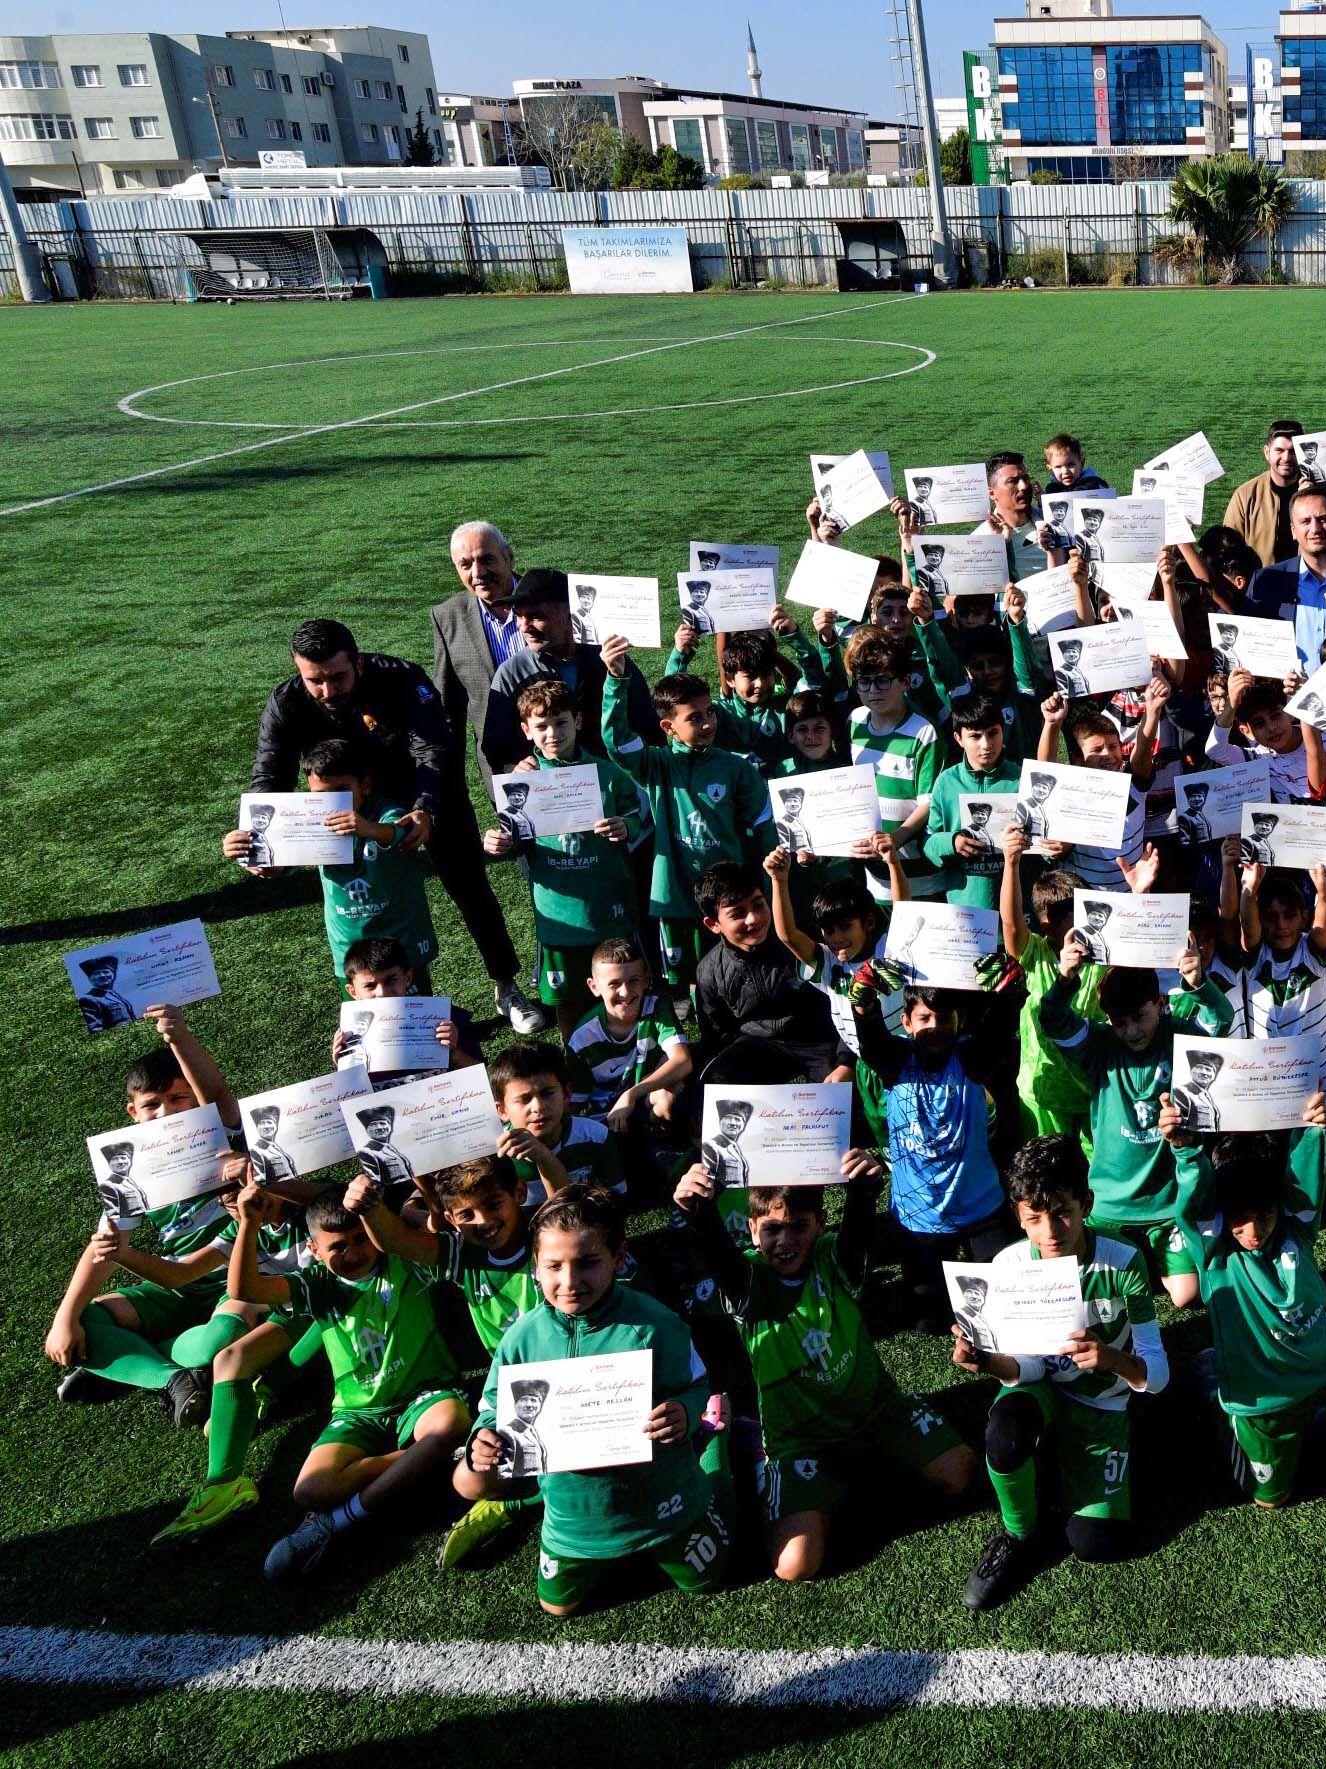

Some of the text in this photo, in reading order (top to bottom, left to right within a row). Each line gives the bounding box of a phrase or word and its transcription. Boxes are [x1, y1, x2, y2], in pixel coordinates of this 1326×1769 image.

[556, 81, 582, 89] PLAZA
[577, 237, 672, 246] TÜM TAKIMLARIMIZA
[584, 249, 632, 259] BAŞARILAR
[612, 905, 624, 918] 14
[418, 940, 429, 954] 10
[1104, 1450, 1128, 1482] 57
[657, 1494, 684, 1519] 22
[685, 1535, 716, 1572] 10
